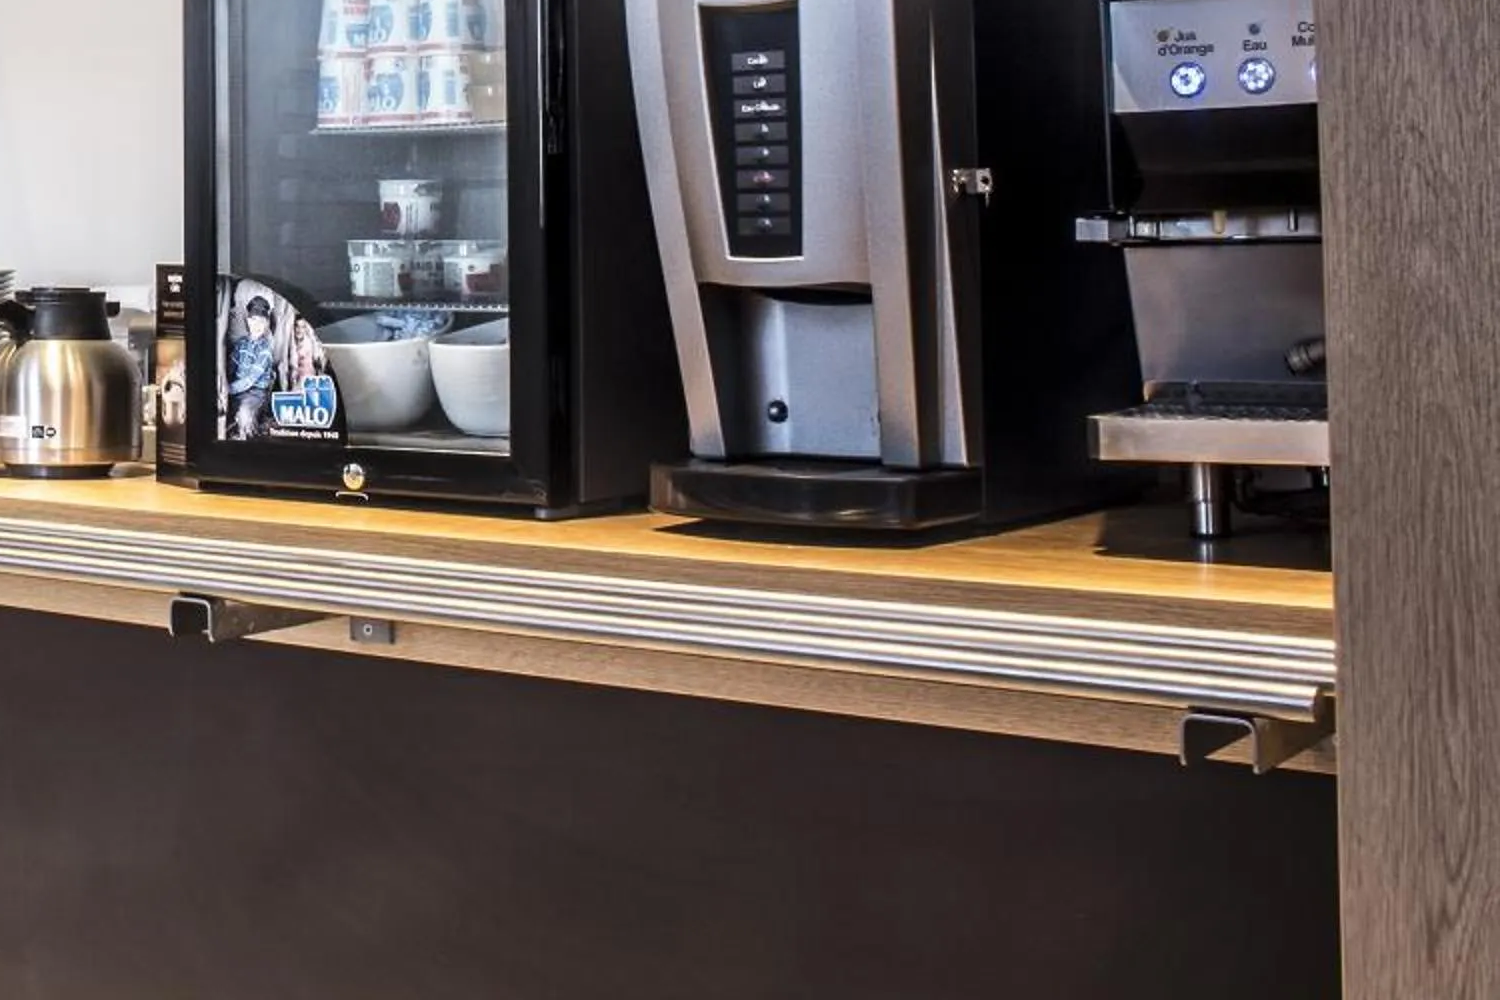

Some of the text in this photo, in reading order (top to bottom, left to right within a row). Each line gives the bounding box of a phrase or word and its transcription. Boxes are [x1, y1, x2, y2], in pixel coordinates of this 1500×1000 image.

[1157, 42, 1215, 57] d'Orange
[1243, 39, 1268, 51] Eau
[280, 405, 329, 426] MALO
